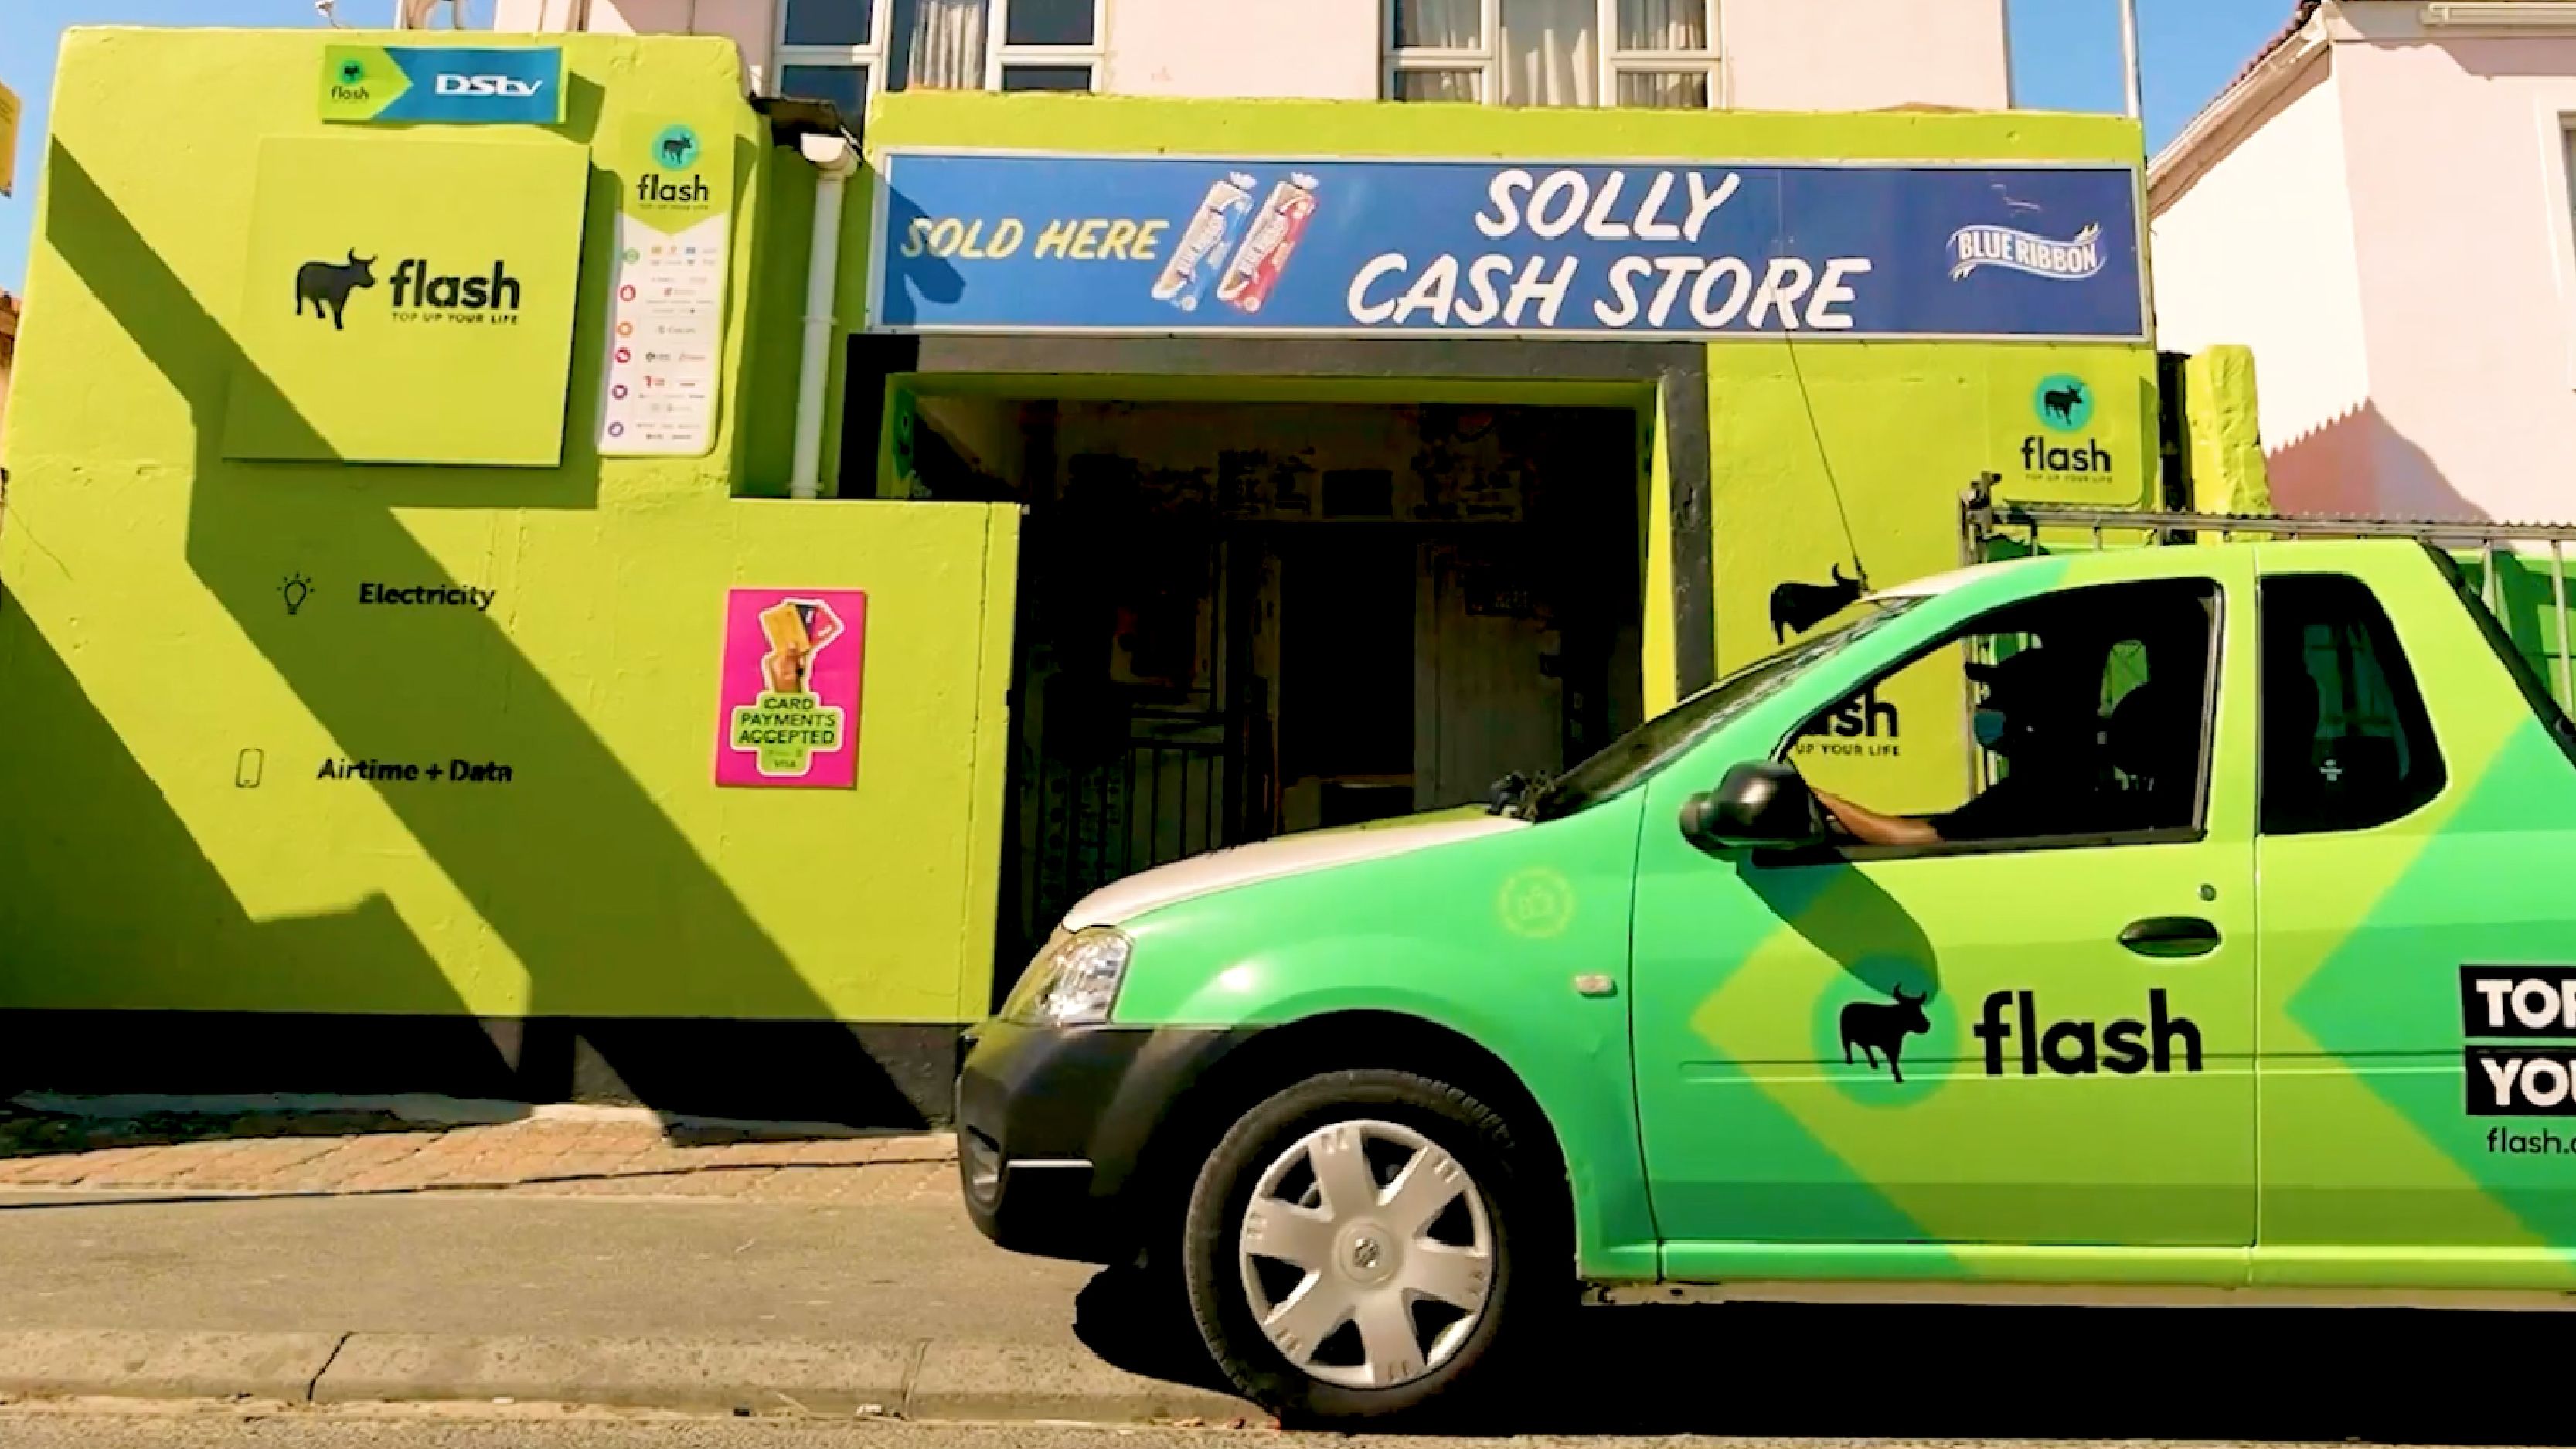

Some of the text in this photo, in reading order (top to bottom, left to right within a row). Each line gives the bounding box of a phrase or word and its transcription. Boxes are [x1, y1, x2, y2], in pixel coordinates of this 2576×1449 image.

[331, 86, 369, 100] flash
[636, 174, 709, 201] flash
[1475, 168, 1741, 242] SOLLY
[900, 216, 1026, 259] SOLD
[1033, 219, 1170, 260] HERE
[1958, 231, 2097, 274] BLUE RIBBON
[388, 259, 520, 308] flash
[1347, 252, 1873, 328] CASH STORE
[392, 312, 418, 322] TOP
[423, 312, 443, 323] UP
[490, 314, 518, 325] LIFE
[2020, 435, 2112, 473] flash
[359, 581, 496, 611] Electricity
[764, 698, 814, 710] CARD
[740, 713, 836, 727] PAYMENTS
[739, 730, 835, 745] ACCEPTED
[317, 758, 420, 781] Airtime
[1972, 987, 2203, 1076] flash
